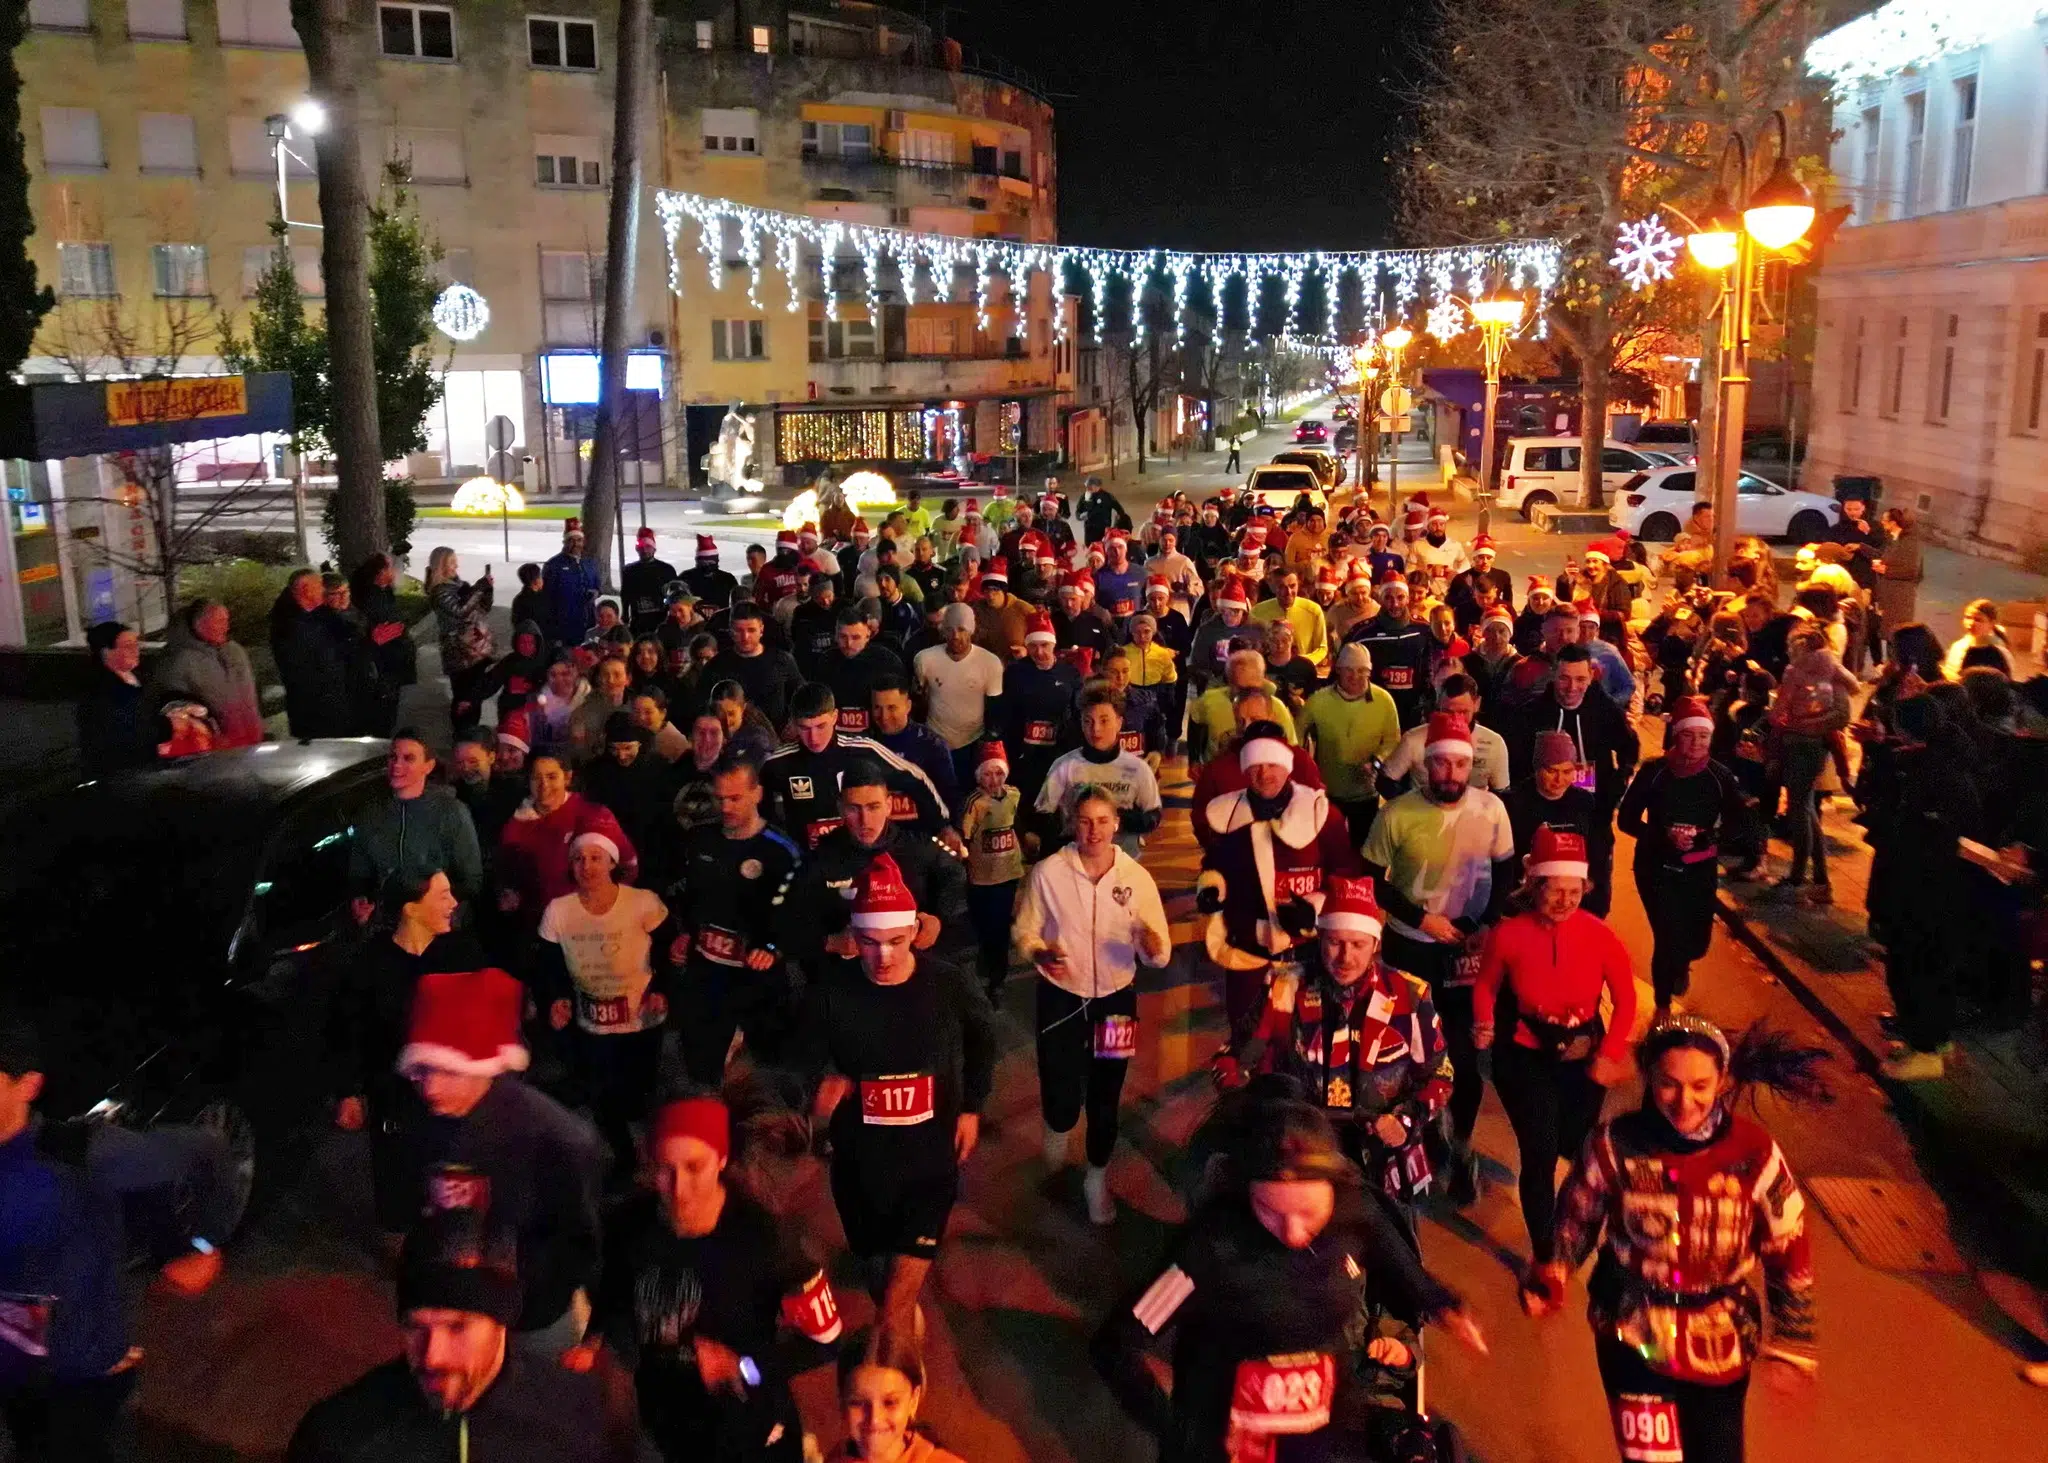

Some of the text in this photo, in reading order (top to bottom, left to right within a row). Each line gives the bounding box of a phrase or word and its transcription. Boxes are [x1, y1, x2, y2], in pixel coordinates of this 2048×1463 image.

[1389, 671, 1408, 683] 139
[841, 712, 863, 726] 002
[1119, 736, 1138, 750] 049
[991, 833, 1013, 850] 005
[1287, 875, 1315, 895] 138
[881, 1086, 915, 1111] 117
[1621, 1409, 1670, 1444] 090
